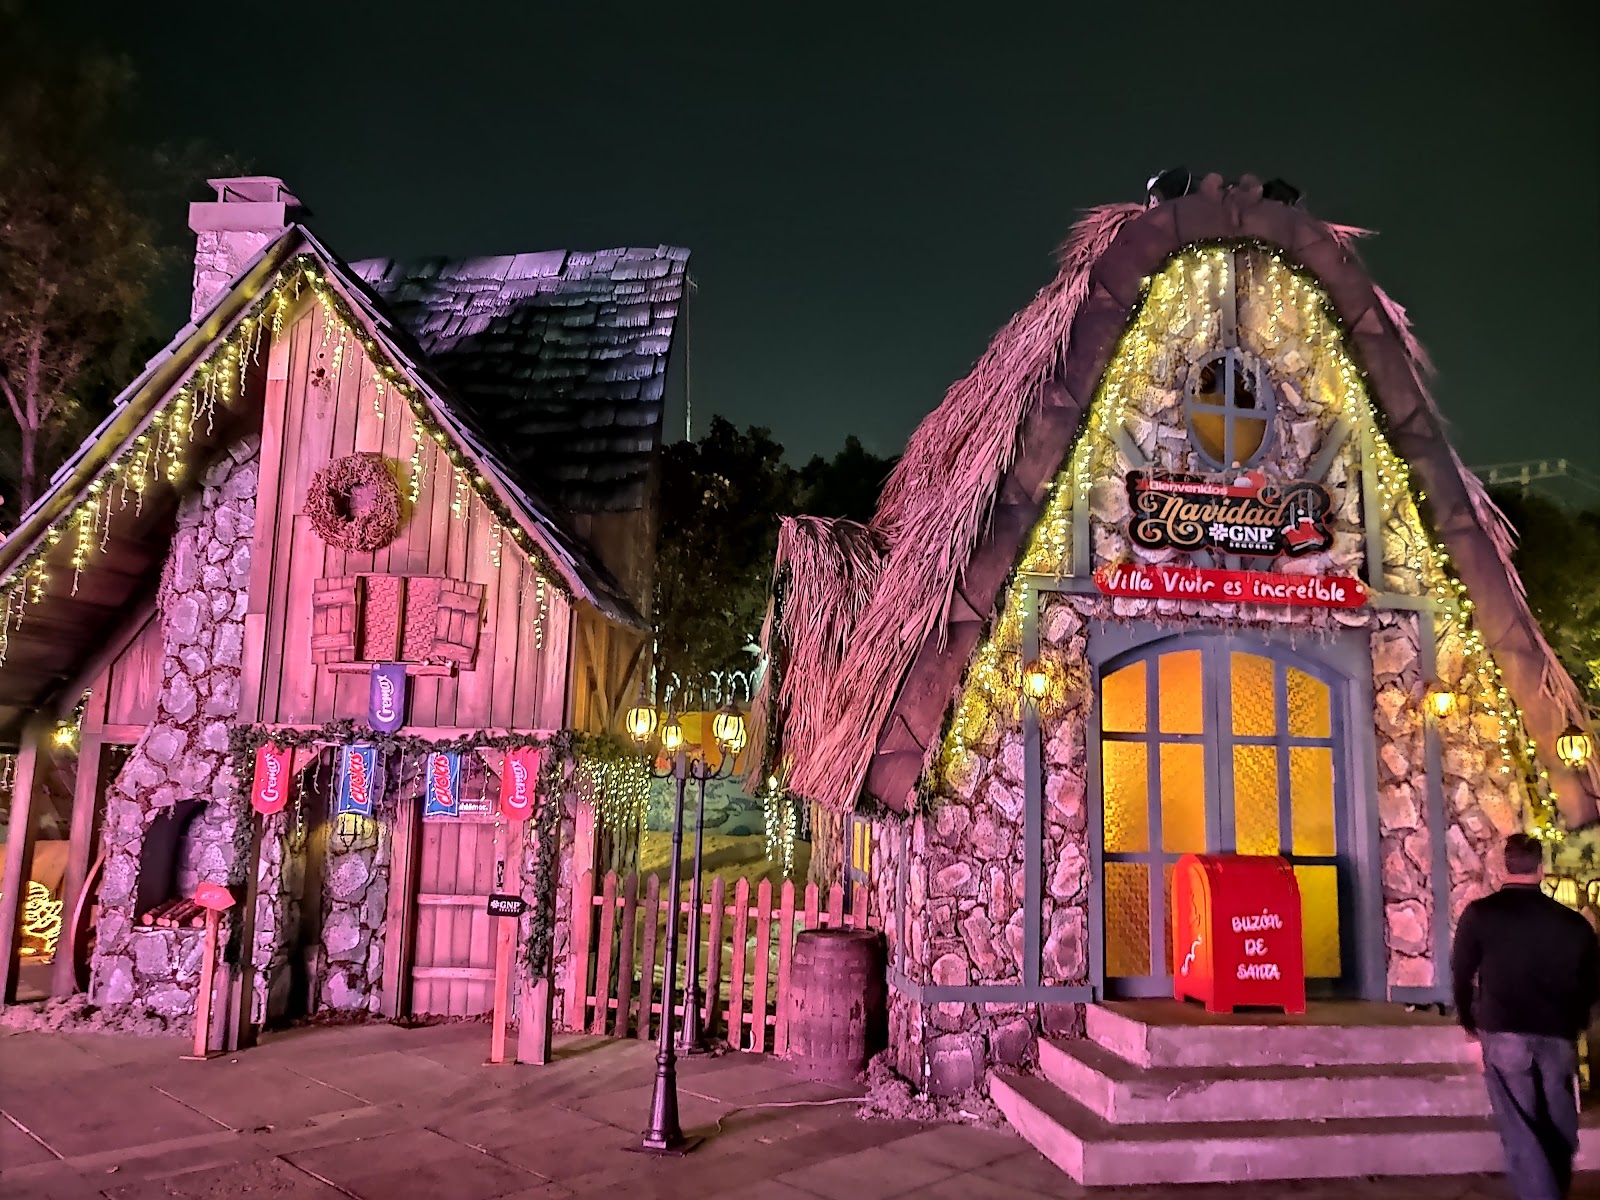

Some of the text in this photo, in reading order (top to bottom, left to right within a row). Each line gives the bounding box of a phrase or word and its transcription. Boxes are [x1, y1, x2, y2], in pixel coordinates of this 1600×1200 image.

[1148, 480, 1228, 496] Bienvenidos
[1145, 495, 1286, 539] Navidad
[1228, 525, 1273, 543] GNP
[1108, 570, 1346, 602] Villa Vivir es increíble
[376, 674, 395, 723] Cremax
[260, 753, 281, 802] Cremax
[508, 759, 528, 809] Cremax
[499, 900, 521, 909] GNP
[1244, 938, 1268, 956] DE
[1236, 963, 1281, 981] SANTA
